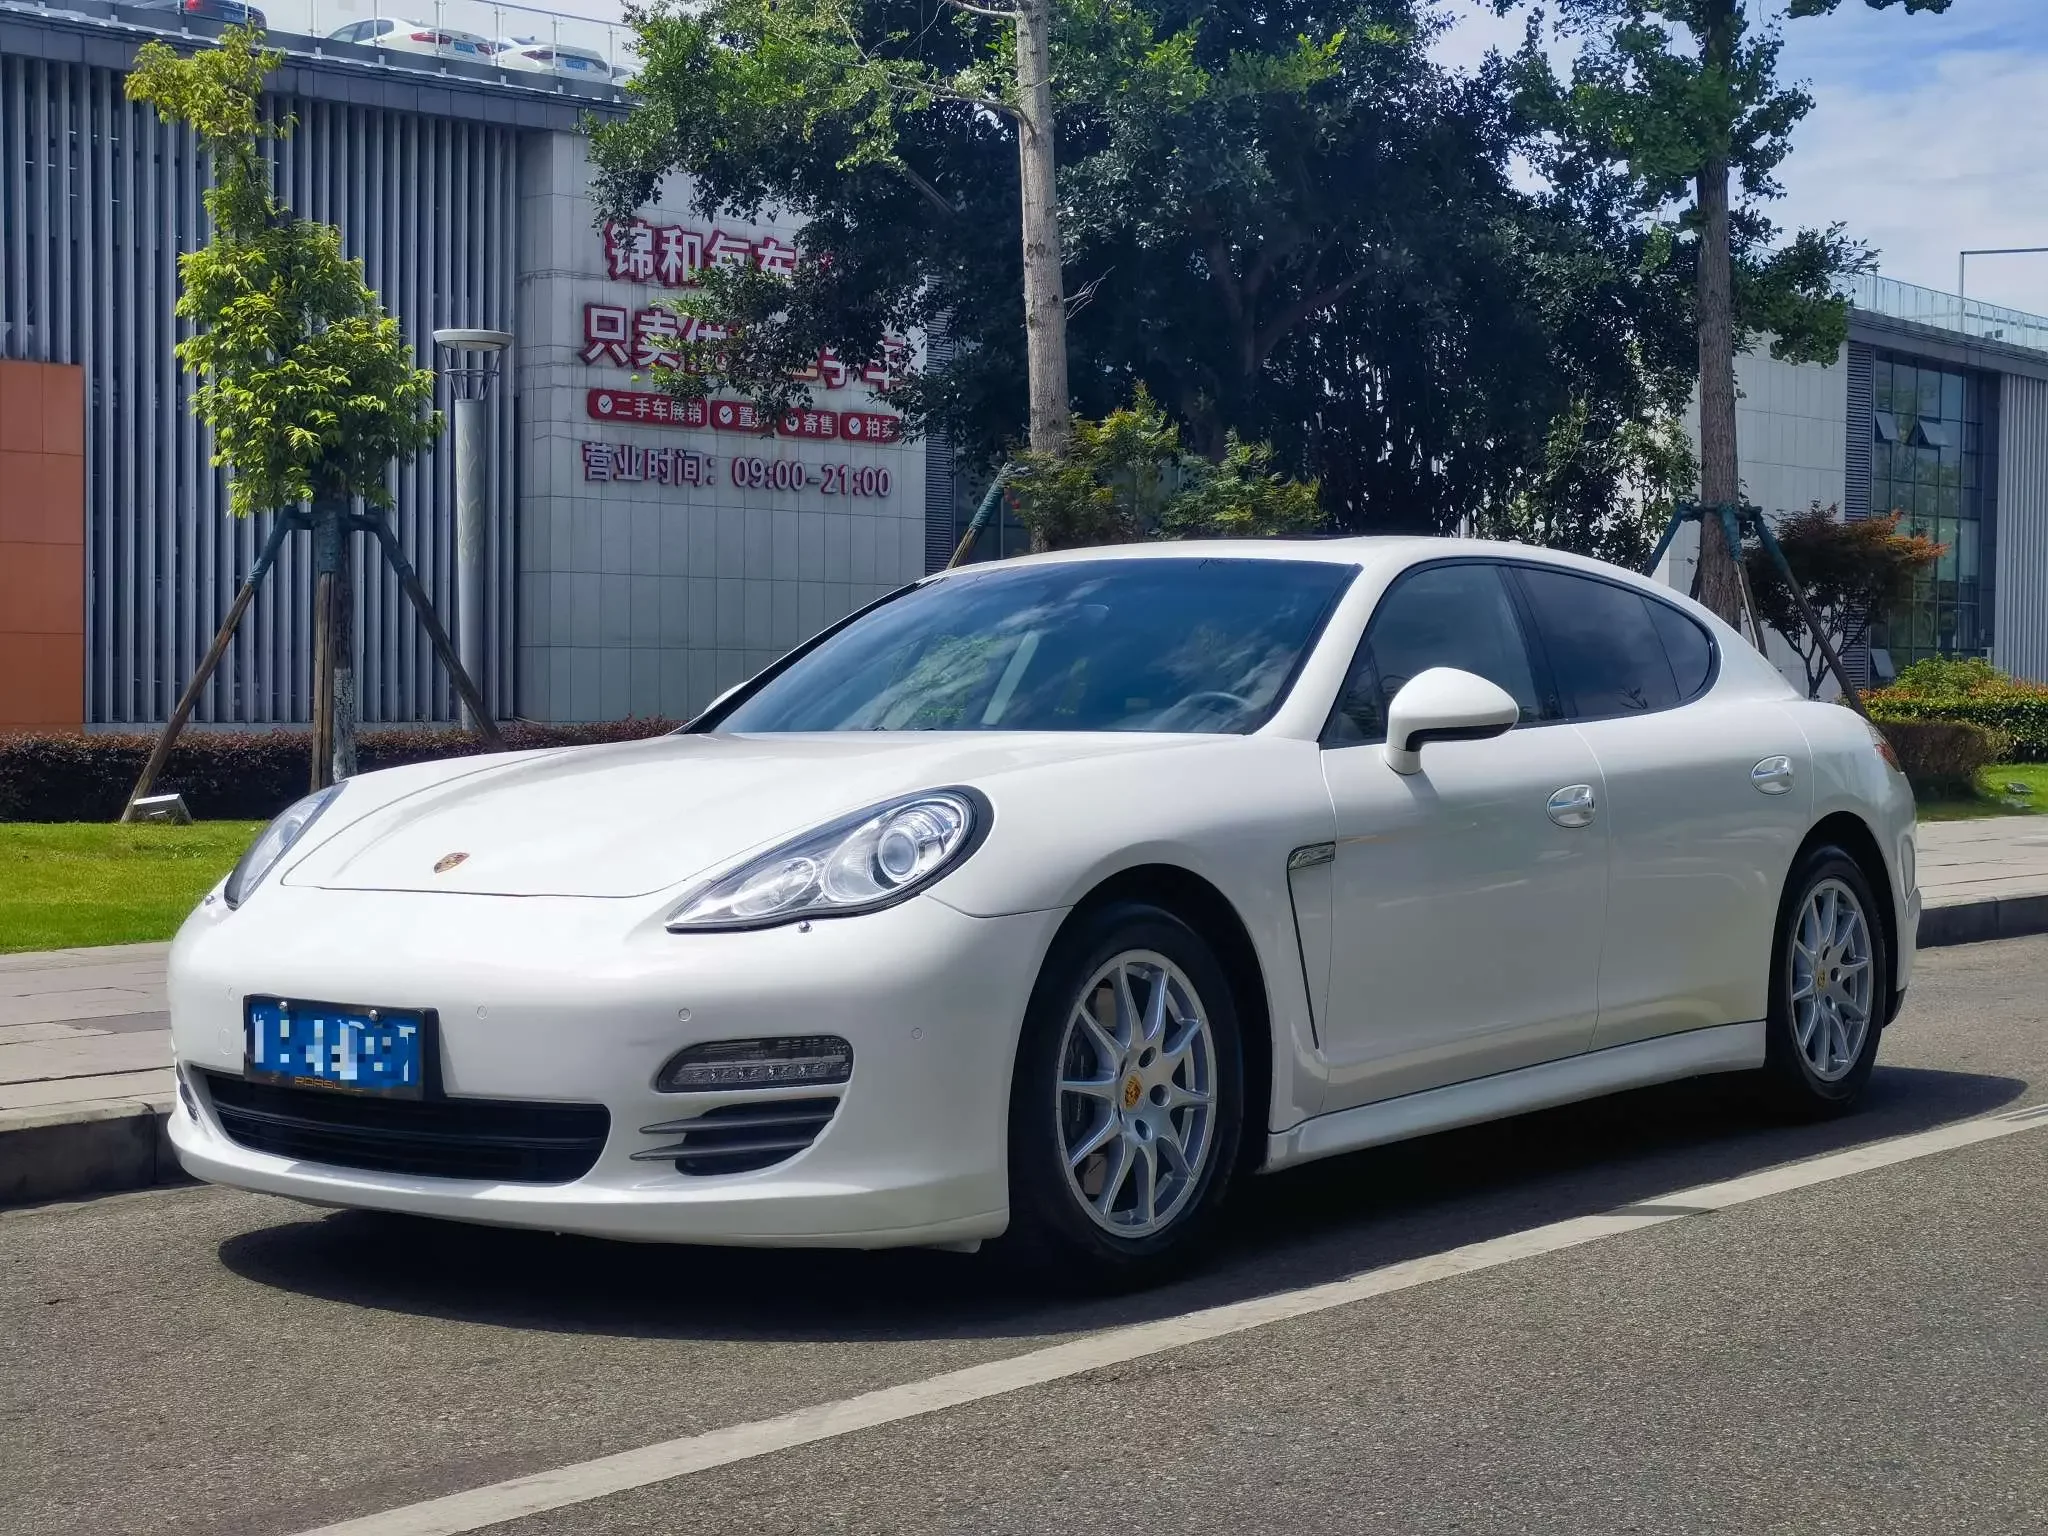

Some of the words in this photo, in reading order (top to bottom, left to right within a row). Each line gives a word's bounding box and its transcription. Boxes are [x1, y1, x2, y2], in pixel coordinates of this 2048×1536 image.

[615, 397, 702, 424] 二手车展销
[803, 413, 833, 435] 寄售
[732, 456, 892, 497] 09:00-21:00
